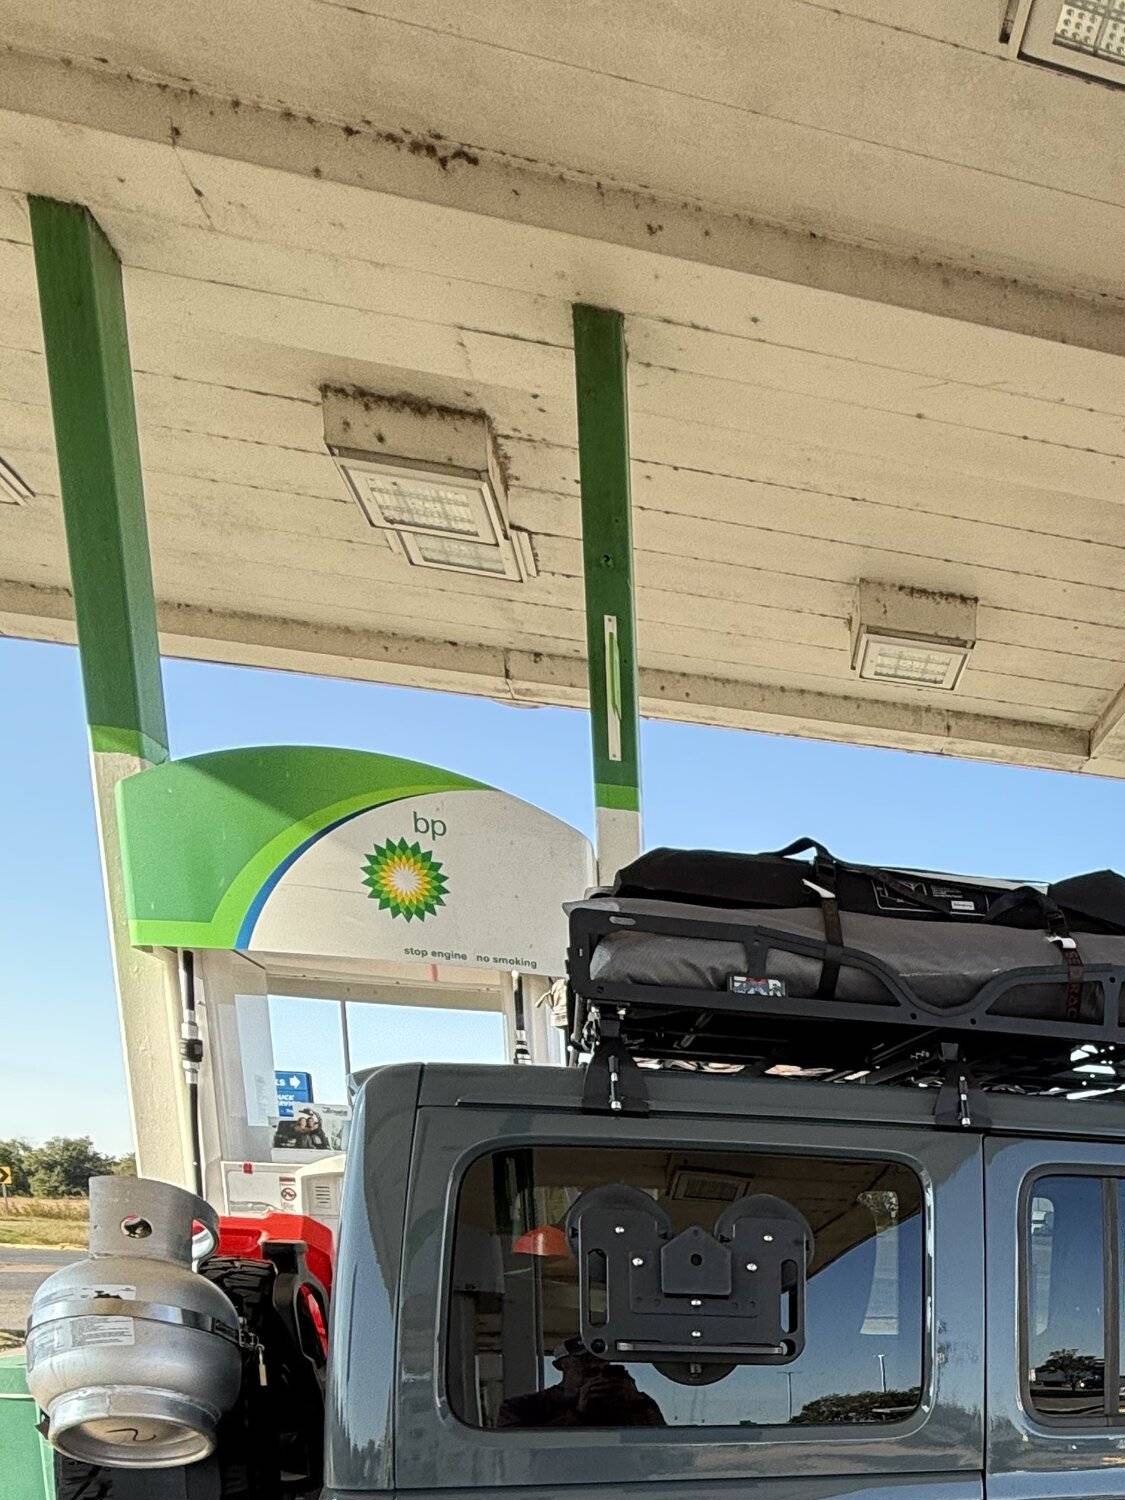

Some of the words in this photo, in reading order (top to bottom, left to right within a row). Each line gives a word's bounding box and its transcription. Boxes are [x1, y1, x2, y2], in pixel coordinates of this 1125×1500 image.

[413, 811, 447, 841] bp
[404, 947, 428, 958] stop
[431, 949, 468, 961] engine
[476, 954, 490, 963] no
[493, 956, 538, 969] smoking
